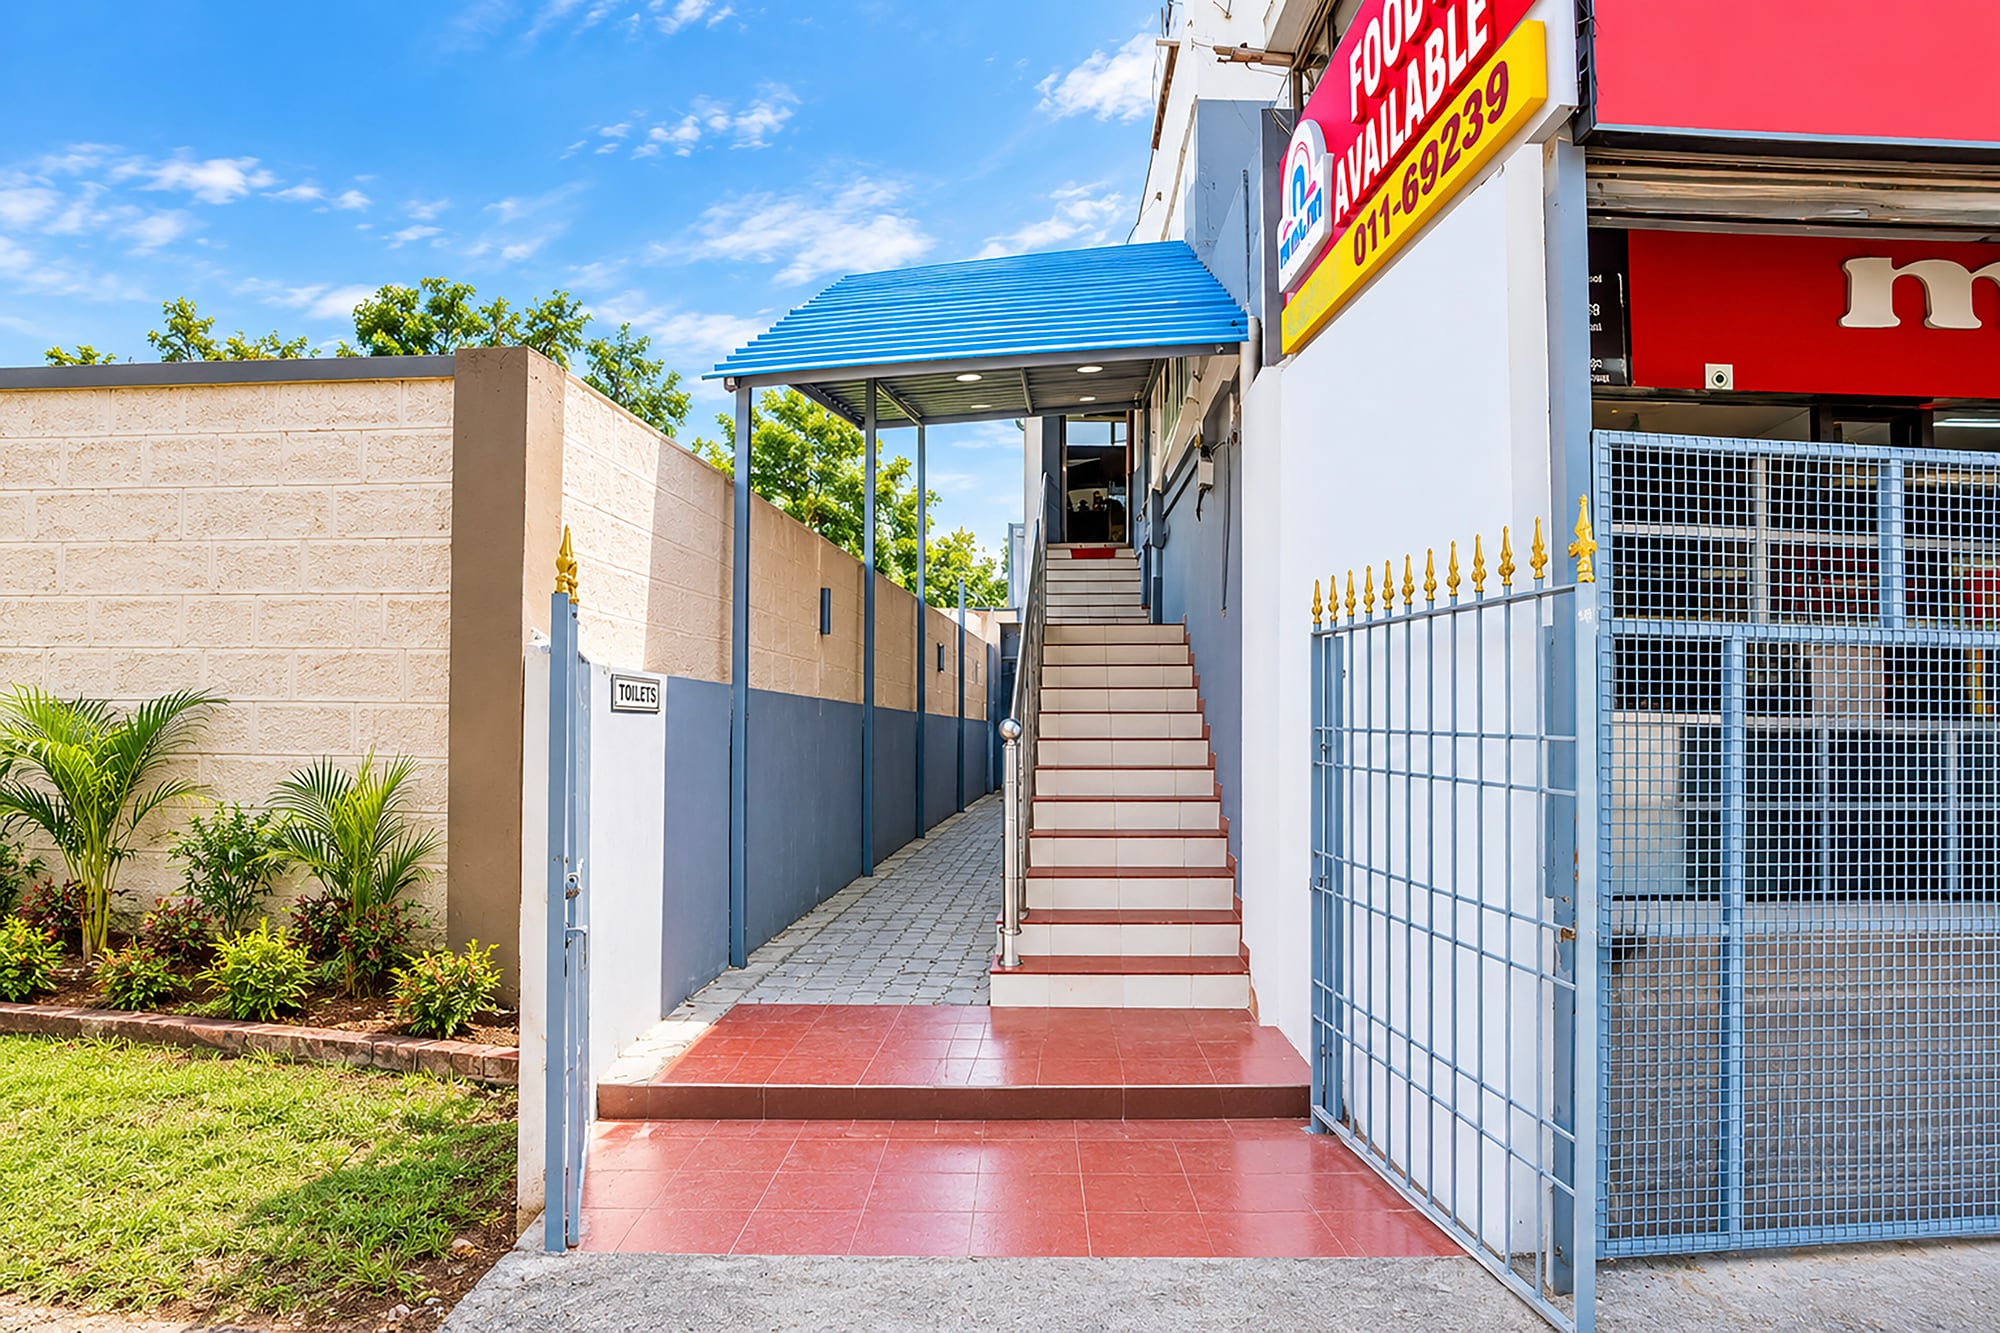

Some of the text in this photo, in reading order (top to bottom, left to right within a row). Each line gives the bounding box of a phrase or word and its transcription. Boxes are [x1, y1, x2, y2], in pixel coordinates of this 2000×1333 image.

[1334, 0, 1488, 226] AVAILABLE
[1353, 60, 1509, 266] 011-69239
[618, 684, 657, 703] TOILETS
